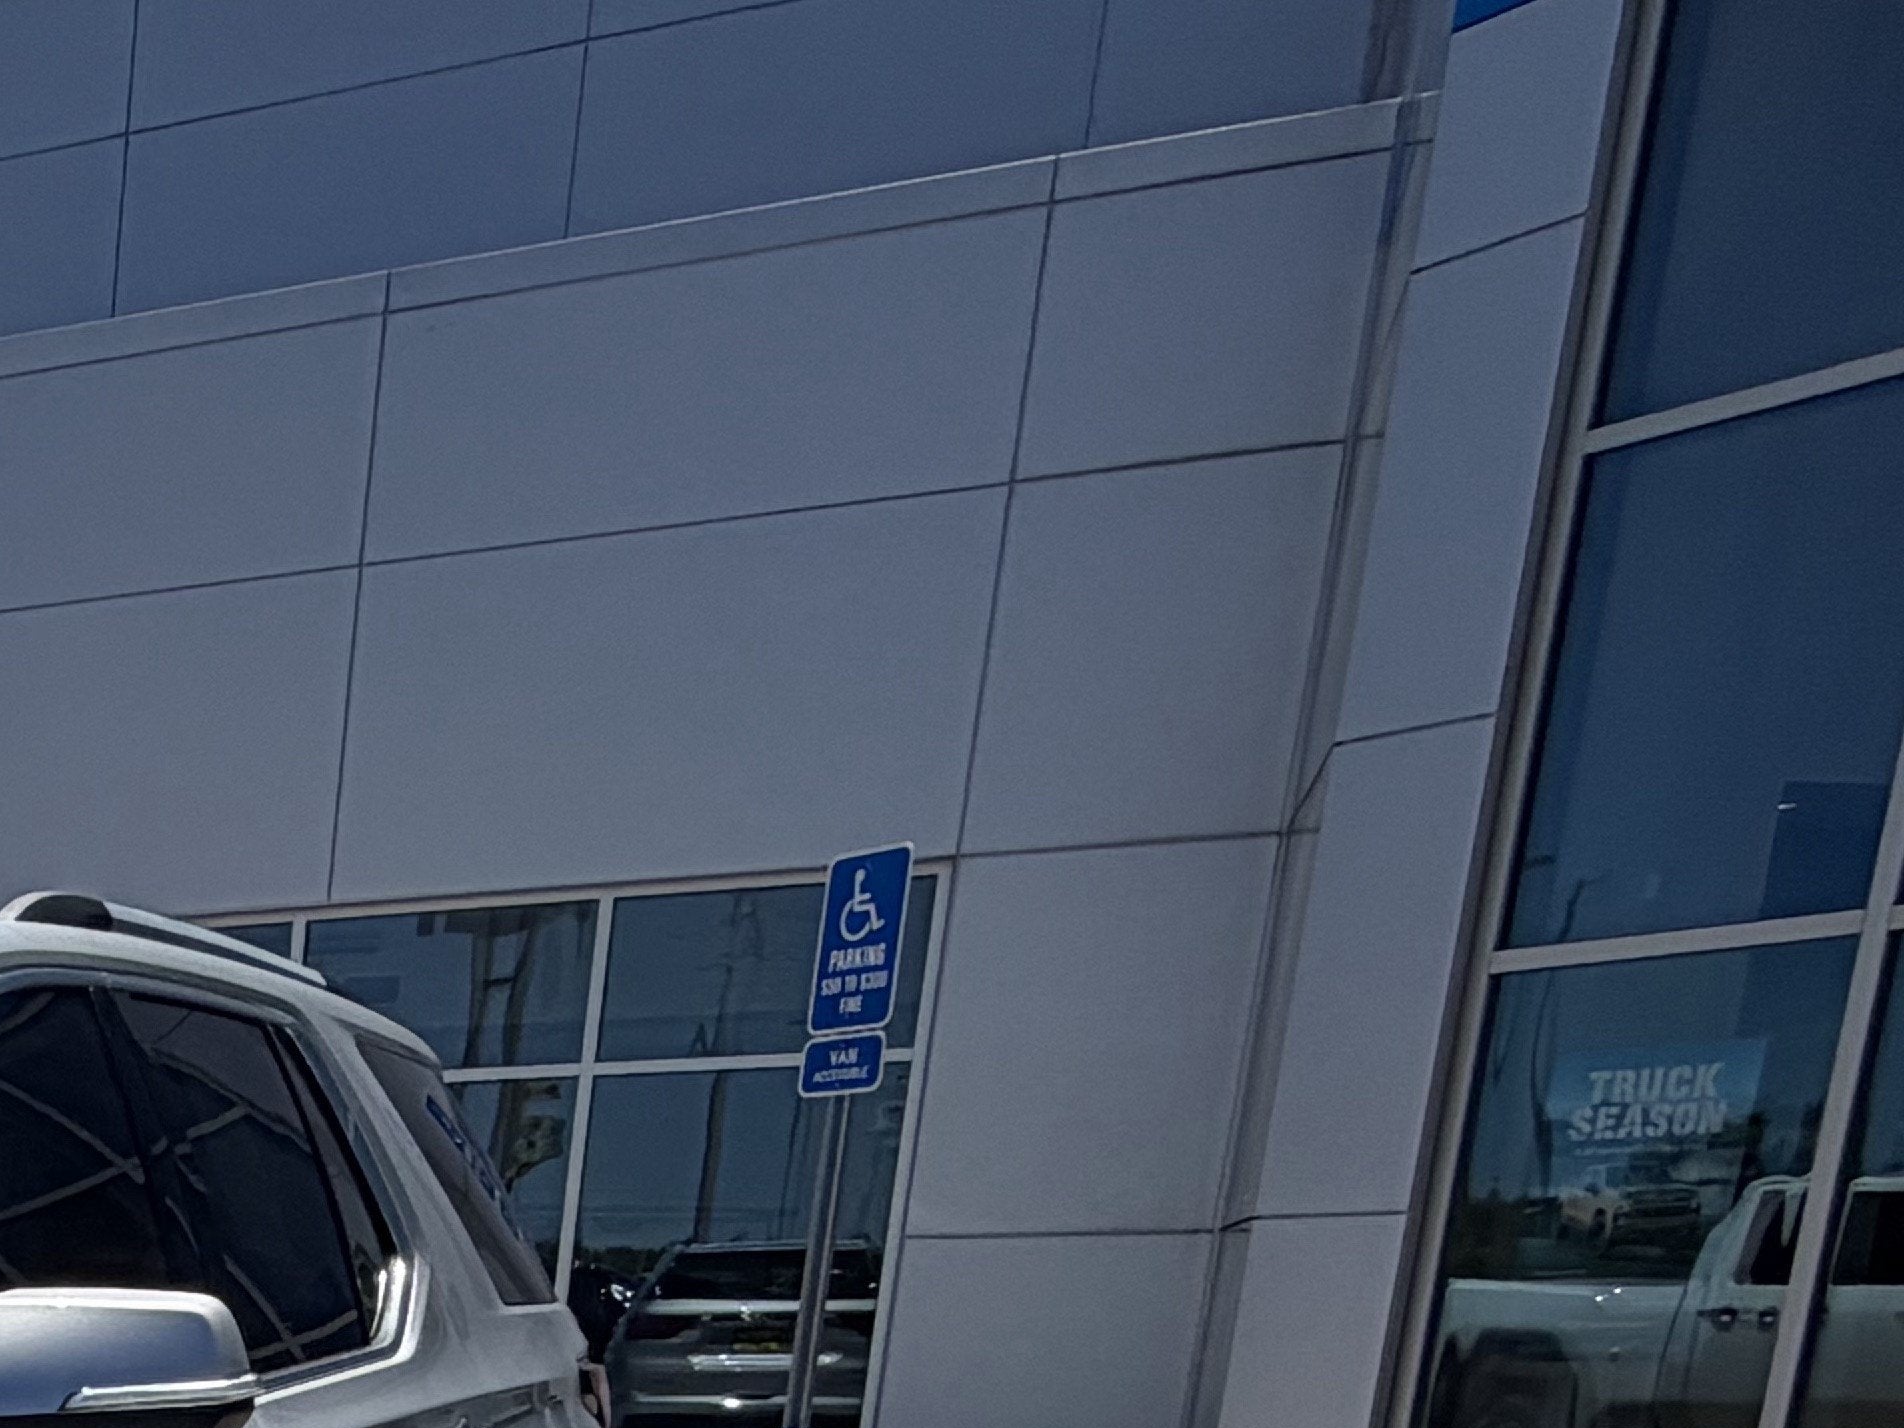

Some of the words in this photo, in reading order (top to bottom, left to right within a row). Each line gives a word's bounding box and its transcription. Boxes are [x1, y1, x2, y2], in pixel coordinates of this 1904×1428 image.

[828, 943, 886, 973] PARKING
[829, 1047, 859, 1066] VAN
[1588, 1062, 1725, 1105] TRUCK
[1567, 1102, 1727, 1141] SEASON
